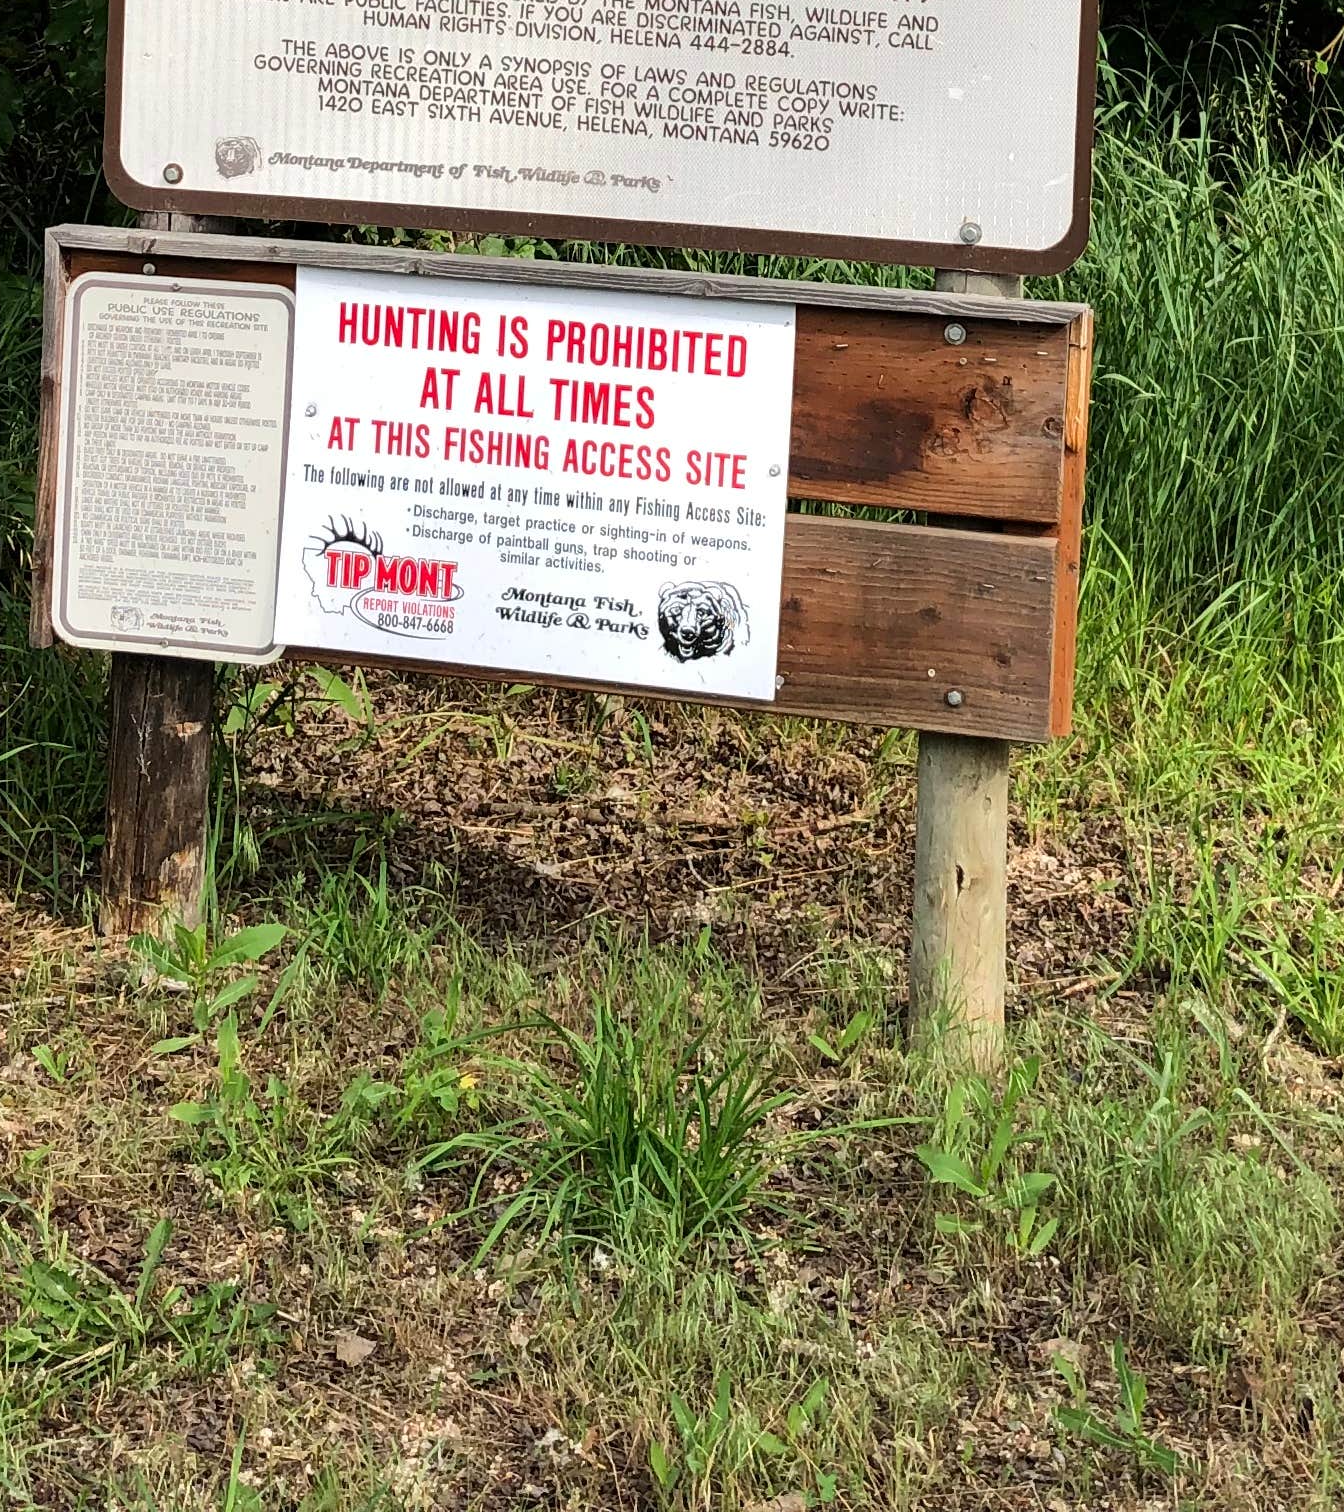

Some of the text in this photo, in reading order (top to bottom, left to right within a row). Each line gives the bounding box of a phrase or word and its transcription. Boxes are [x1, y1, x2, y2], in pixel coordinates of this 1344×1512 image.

[363, 9, 794, 58] HUMAN RIGHTS DIVISION, HELENA 444-2884.
[749, 1, 795, 23] FISH,
[804, 6, 887, 29] WILDLIFE
[897, 13, 938, 32] AND
[254, 56, 904, 122] GOVERNING RECREATION AREA USE. FOR A COMPLETE COPY WRITE:
[317, 76, 834, 134] MONTANA DEPARTMENT OF FISH WILDLIFE AND PARKS
[318, 94, 829, 152] 1420 EAST SIXTH AVENUE, HELENA, MONTANA 59620
[107, 303, 260, 322] PUBLIC USE REGULATIONS
[338, 301, 746, 378] HUNTING IS PROHIBITED
[419, 366, 654, 429] AT ALL TIMES
[327, 416, 746, 489] AT THIS FISHING ACCESS SITE
[303, 463, 765, 527] The following are not allowed at any time within any Fishing Access Site:
[478, 532, 491, 544] of
[496, 534, 549, 550] paintball
[554, 541, 587, 556] guns,
[593, 543, 617, 560] trap
[623, 546, 677, 566] shooting
[683, 555, 696, 565] or
[483, 511, 520, 529] target
[525, 518, 575, 533] practice
[581, 524, 594, 534] or
[599, 523, 666, 543] sighting-in
[671, 531, 685, 544] of
[690, 535, 750, 550] weapons.
[323, 549, 458, 600] TIP MONT
[499, 551, 604, 573] similar activities.
[362, 596, 455, 619] REPORT VIOLATIONS
[375, 613, 453, 634] 800-847-6668
[494, 606, 648, 639] Wildlife & Parks
[499, 587, 642, 618] Montana Fish,
